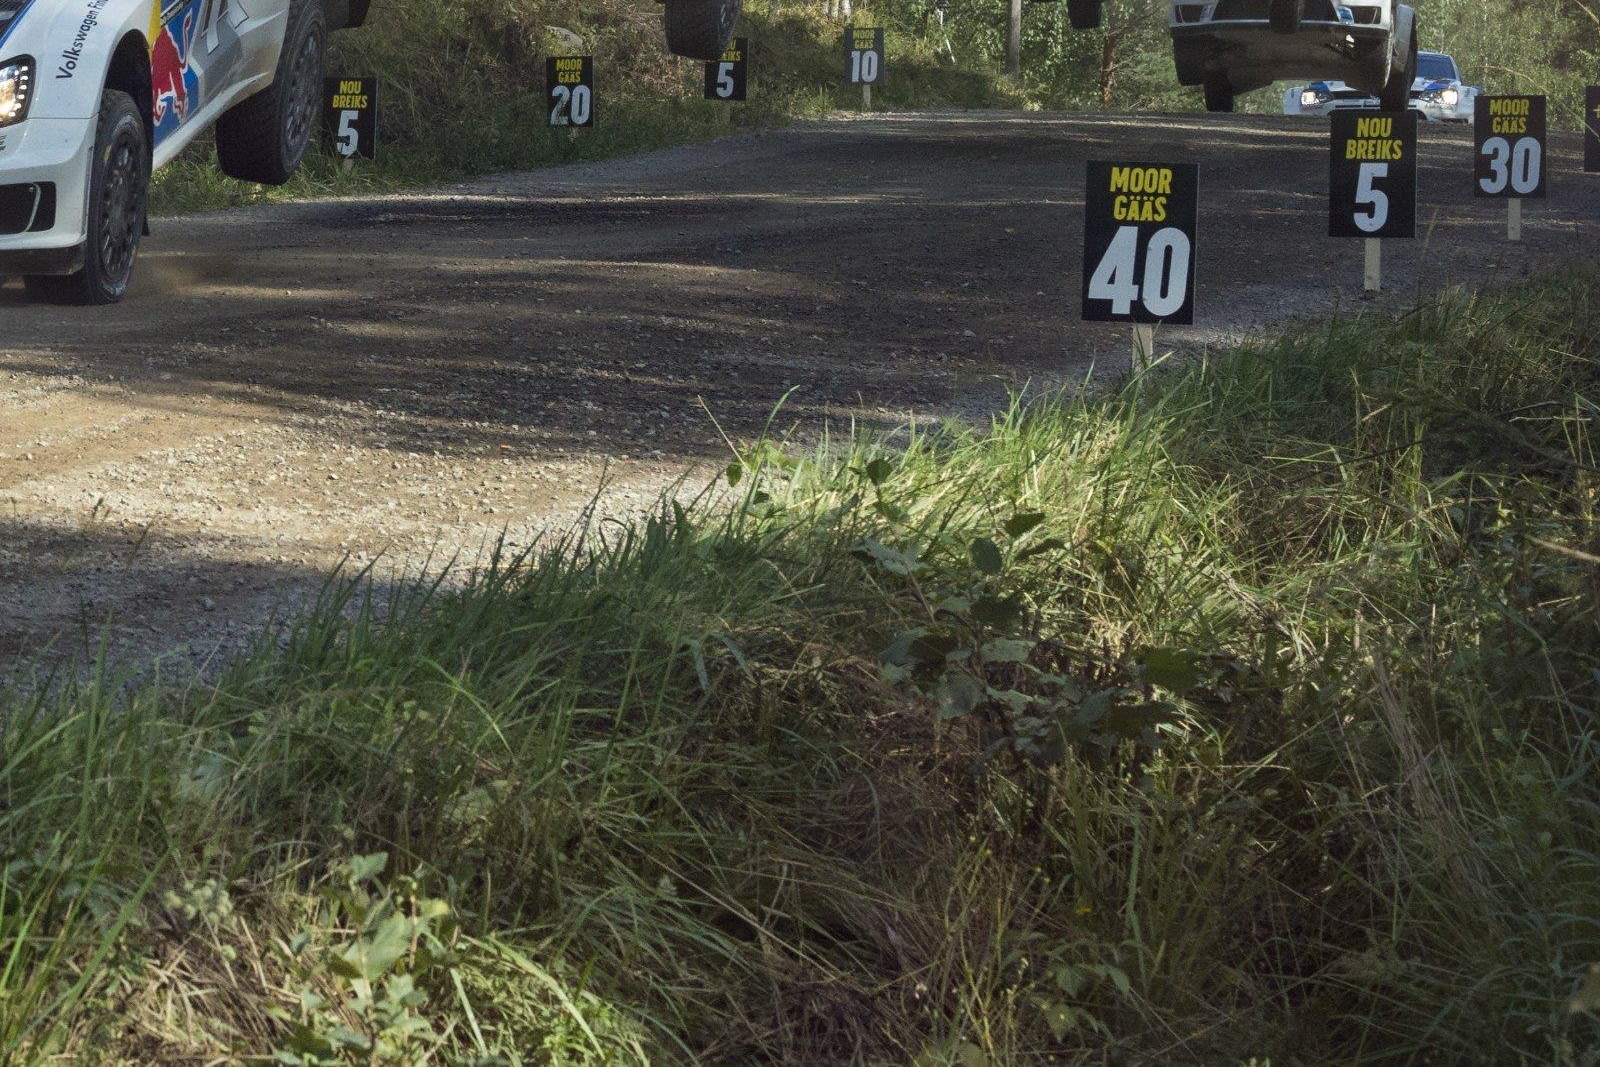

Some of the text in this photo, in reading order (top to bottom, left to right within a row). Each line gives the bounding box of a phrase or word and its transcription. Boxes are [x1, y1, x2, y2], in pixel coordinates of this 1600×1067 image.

[55, 9, 100, 80] Volkswagen
[556, 58, 583, 72] MOOR
[851, 50, 878, 83] 10
[338, 80, 362, 95] NOU
[716, 62, 735, 98] 5
[332, 94, 368, 109] BREIKS
[551, 84, 591, 126] 20
[1489, 98, 1530, 117] MOOR
[336, 110, 359, 157] 5
[1356, 117, 1393, 138] NOU
[1492, 114, 1527, 134] GÄÄS
[1346, 139, 1403, 162] BREIKS
[1479, 136, 1542, 195] 30
[1109, 166, 1173, 194] MOOR
[1113, 195, 1167, 223] GÄÄS
[1353, 162, 1389, 233] 5
[1088, 225, 1192, 317] 40
